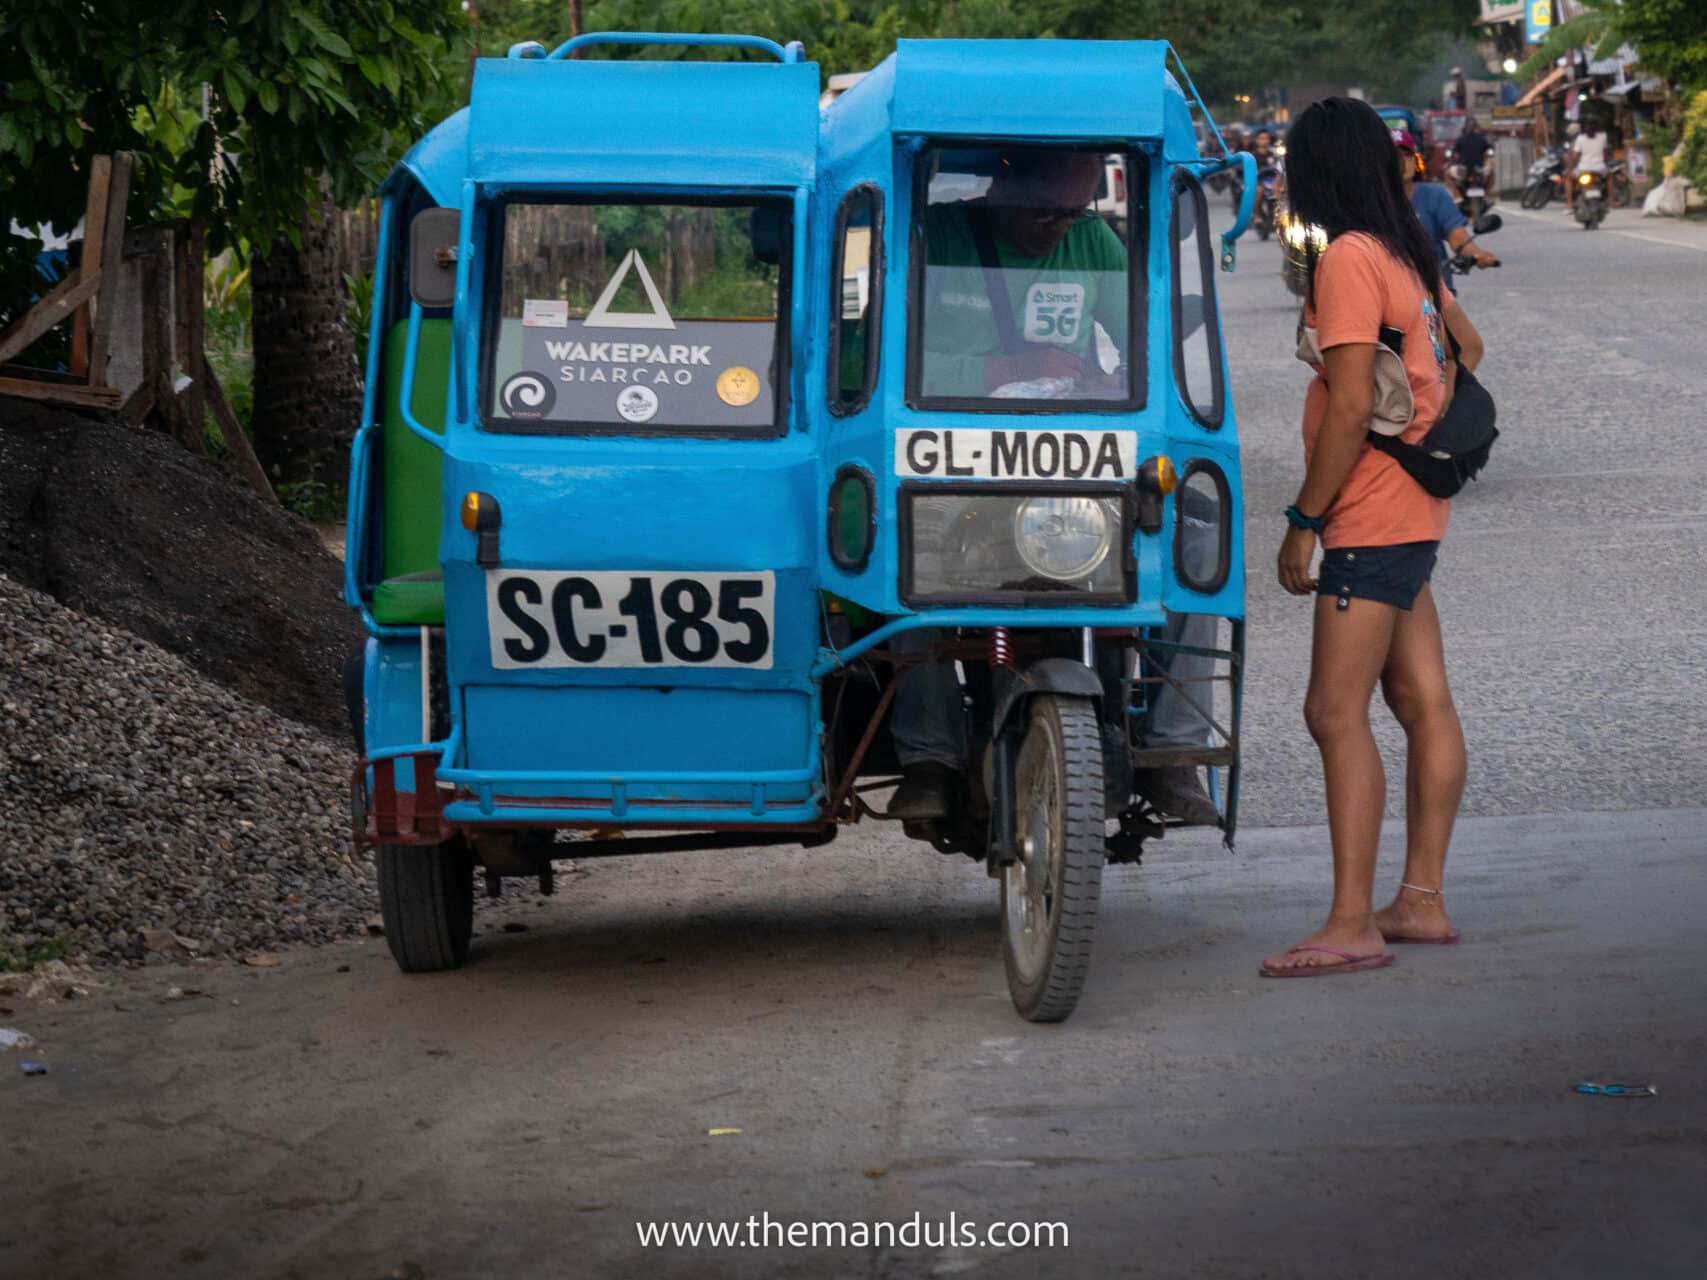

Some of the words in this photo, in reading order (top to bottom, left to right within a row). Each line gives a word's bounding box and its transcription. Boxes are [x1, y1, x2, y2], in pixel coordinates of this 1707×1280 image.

[1047, 291, 1078, 303] Smart
[1034, 307, 1077, 336] 5G
[545, 340, 712, 366] WAKEPARK
[907, 430, 1124, 478] GL-MODA
[497, 577, 770, 664] SC-185
